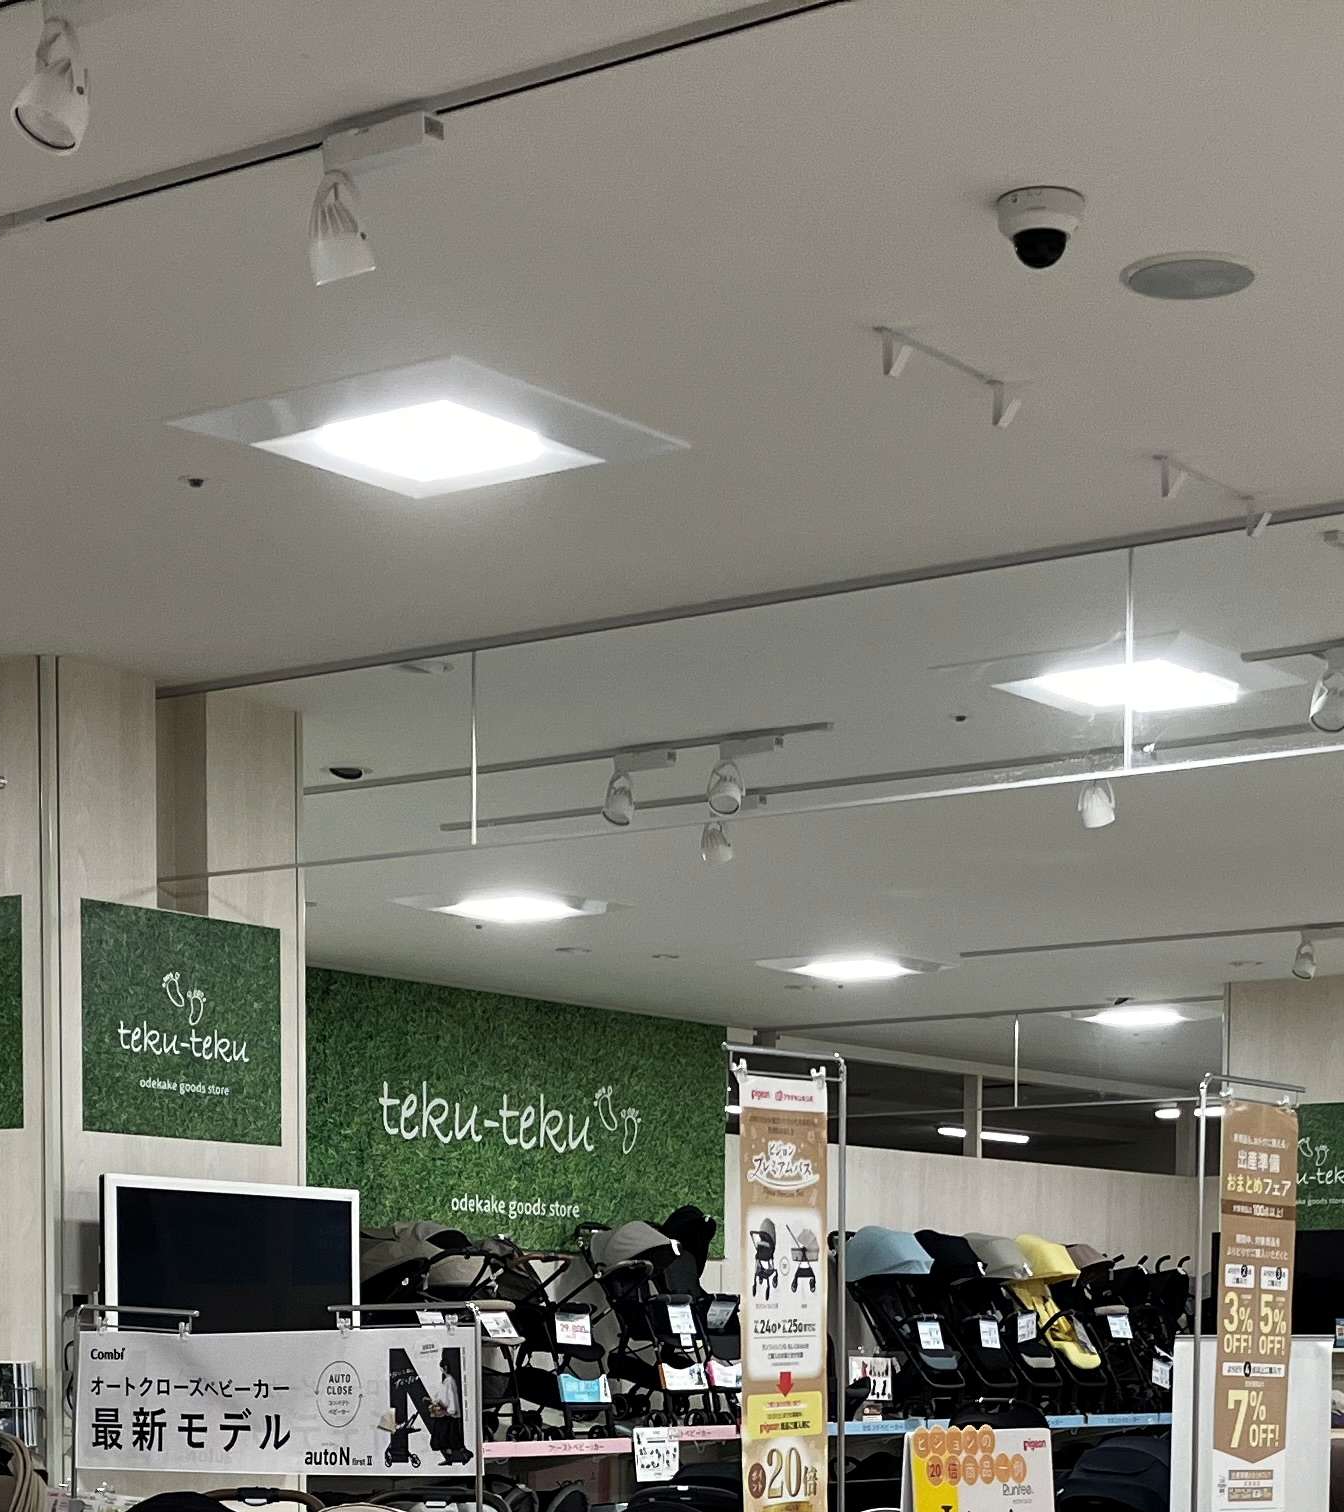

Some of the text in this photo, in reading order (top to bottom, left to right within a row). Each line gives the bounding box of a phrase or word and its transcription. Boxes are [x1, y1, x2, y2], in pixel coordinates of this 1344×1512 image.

[117, 1020, 250, 1064] teku-teku
[139, 1077, 230, 1097] odekake goods store
[377, 1080, 594, 1153] teku-teku
[450, 1195, 580, 1220] odekake goods store
[90, 1347, 126, 1361] Combi
[1223, 1334, 1252, 1354] OFF!
[1258, 1336, 1286, 1356] OFF!
[91, 1376, 291, 1399] オートクローズベビーカー
[328, 1374, 351, 1383] AUTO
[326, 1386, 353, 1396] CLOSE
[90, 1406, 292, 1453] 最新モデル
[1249, 1424, 1280, 1448] OFF!
